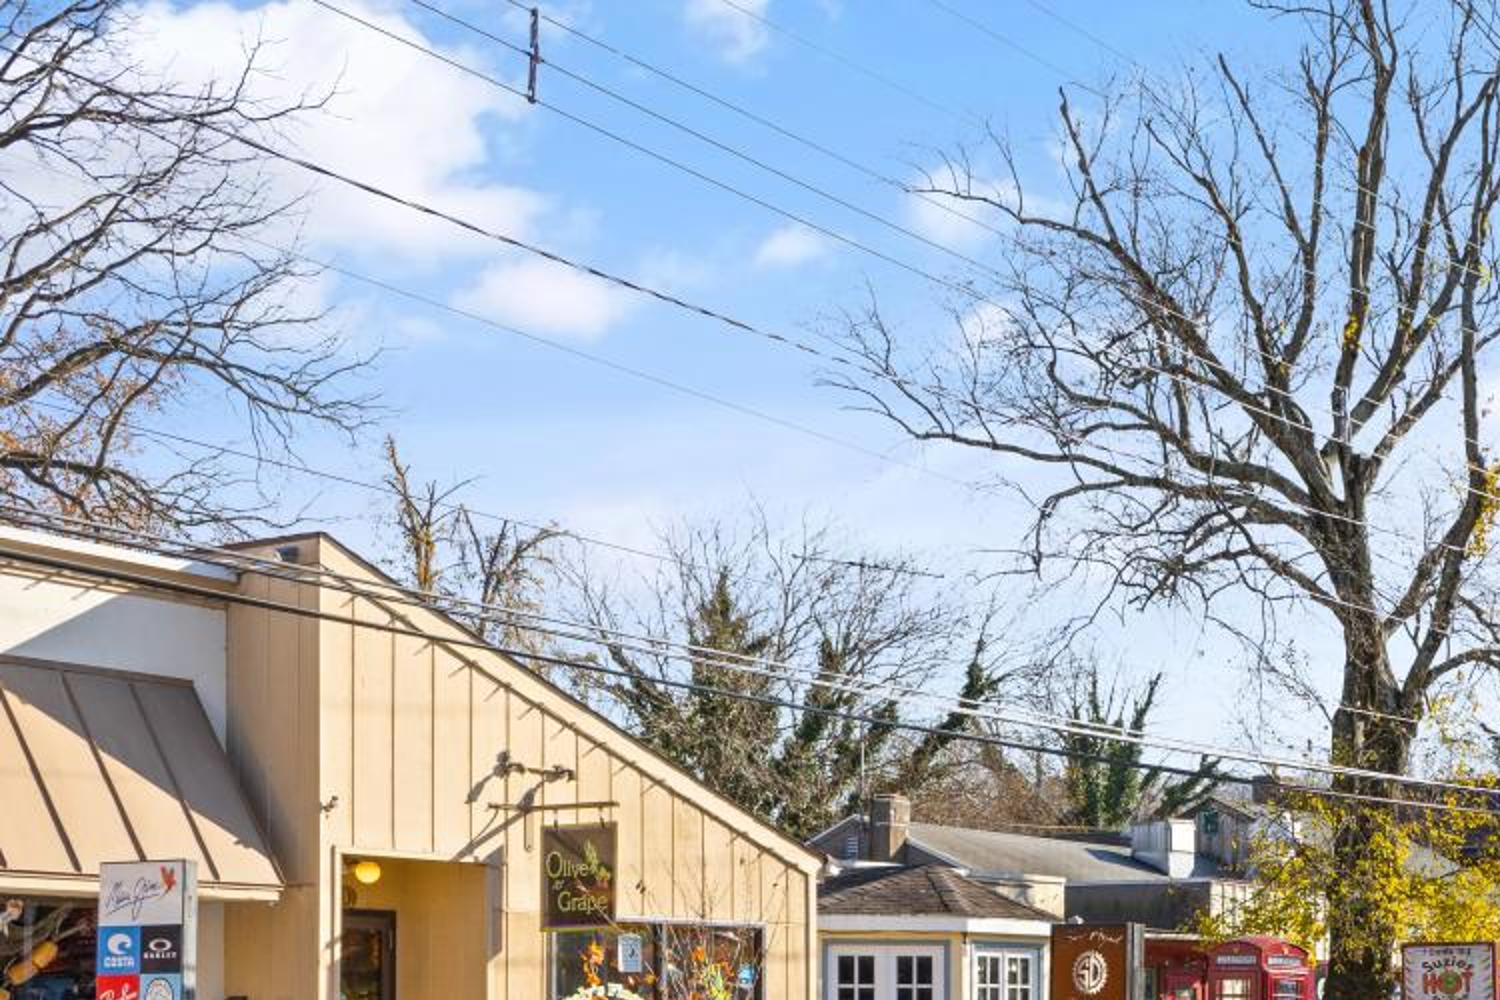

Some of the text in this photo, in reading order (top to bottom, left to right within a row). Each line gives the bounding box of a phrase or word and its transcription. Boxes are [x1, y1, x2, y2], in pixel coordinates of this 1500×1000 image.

[545, 851, 589, 879] Olive
[557, 891, 609, 915] Grape
[103, 956, 135, 969] COSTA
[1423, 971, 1474, 995] HOT
